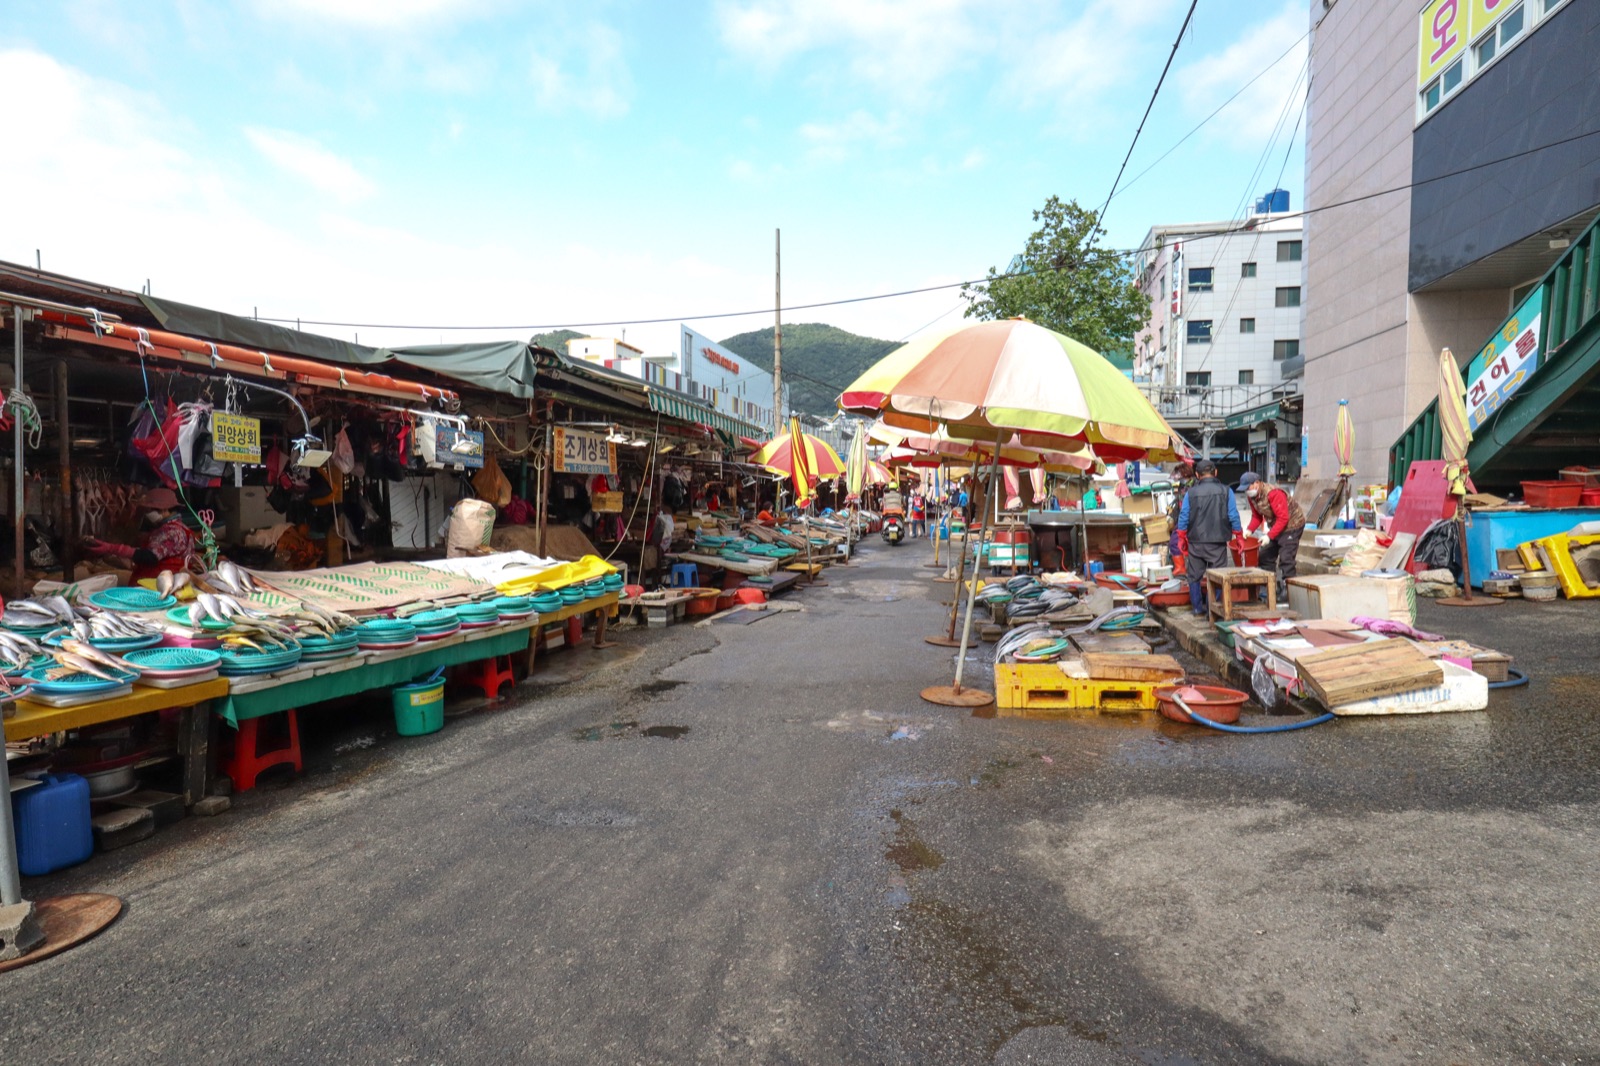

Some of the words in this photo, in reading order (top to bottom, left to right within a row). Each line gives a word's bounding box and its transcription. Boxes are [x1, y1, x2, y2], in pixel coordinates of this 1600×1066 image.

[1469, 328, 1537, 408] 건어물
[217, 424, 257, 446] 밀양상회
[564, 434, 609, 463] 조개상회
